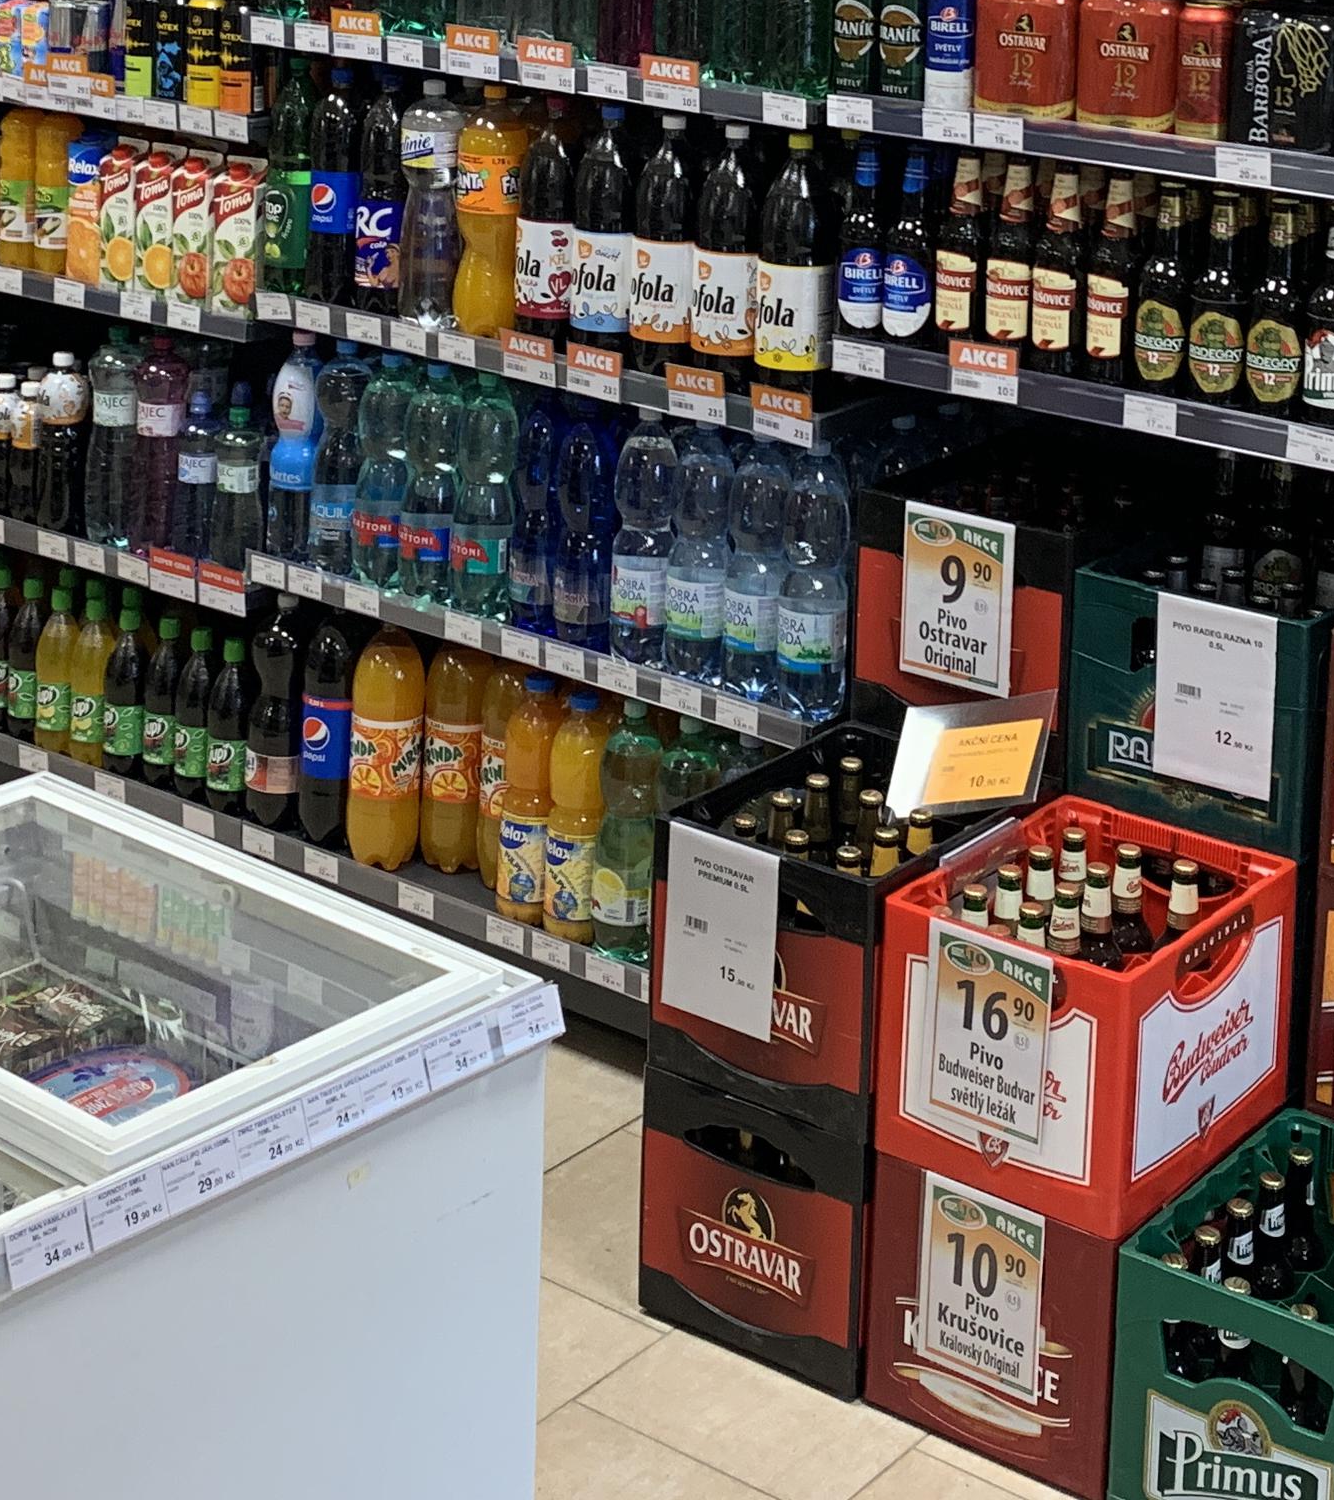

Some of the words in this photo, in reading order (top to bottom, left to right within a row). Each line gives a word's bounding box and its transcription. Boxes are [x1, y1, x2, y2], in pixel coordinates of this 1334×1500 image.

[339, 16, 373, 31] AKCE
[930, 21, 969, 34] BIRELL
[454, 33, 491, 49] AKCE
[998, 33, 1047, 53] OSTRAVAR
[526, 45, 565, 63] AKCE
[1100, 43, 1150, 63] OSTRAVAR
[1182, 56, 1222, 70] OSTRAVAR
[52, 57, 81, 73] AKCE
[648, 62, 691, 81] AKCE
[1012, 54, 1034, 80] 12
[1114, 63, 1136, 89] 12
[1189, 72, 1211, 91] 12
[1249, 34, 1273, 145] BARBORA
[69, 156, 98, 178] Relax
[101, 173, 130, 193] Toma
[137, 180, 168, 202] Toma
[173, 187, 204, 210] Toma
[214, 192, 253, 216] Toma
[356, 206, 392, 239] RC
[844, 266, 883, 280] BIRELL
[631, 274, 674, 304] ofola
[509, 336, 546, 357] AKCE
[575, 351, 614, 373] AKCE
[959, 349, 1007, 370] AKCE
[1147, 352, 1159, 364] 12
[1246, 353, 1301, 372] RADEGAST
[1207, 363, 1220, 376] 12
[1263, 373, 1276, 386] 12
[675, 373, 715, 392] AKCE
[760, 393, 802, 414] AKCE
[963, 529, 999, 554] AKCE
[940, 555, 966, 603] 9
[973, 561, 992, 582] 90
[937, 608, 967, 630] Pivo
[1172, 621, 1192, 633] PIVO
[919, 621, 988, 655] Ostravar
[924, 645, 976, 675] Original
[958, 733, 987, 747] AKČNÍ
[990, 732, 1018, 745] CENA
[693, 856, 712, 869] PIVO
[713, 861, 755, 885] OSTRAVAR
[697, 869, 733, 891] PREMIUM
[1002, 958, 1043, 993] AKCE
[956, 979, 1009, 1042] 16
[1013, 997, 1035, 1022] 90
[969, 1042, 1004, 1071] Pivo
[1162, 998, 1255, 1105] Budweiser
[1200, 1033, 1250, 1086] Budvar
[938, 1053, 995, 1094] Budweiser
[996, 1078, 1035, 1107] Budvar
[950, 1086, 984, 1115] světlý
[985, 1096, 1016, 1126] ležák
[995, 1215, 1035, 1250] AKCE
[688, 1222, 802, 1297] OSTRAVAR
[947, 1232, 998, 1298] 10
[1004, 1254, 1026, 1279] 90
[965, 1293, 999, 1322] Pivo
[937, 1302, 1025, 1358] Krušovice
[939, 1330, 983, 1365] Královský
[983, 1349, 1020, 1379] Originál
[1165, 1429, 1302, 1500] Primus
